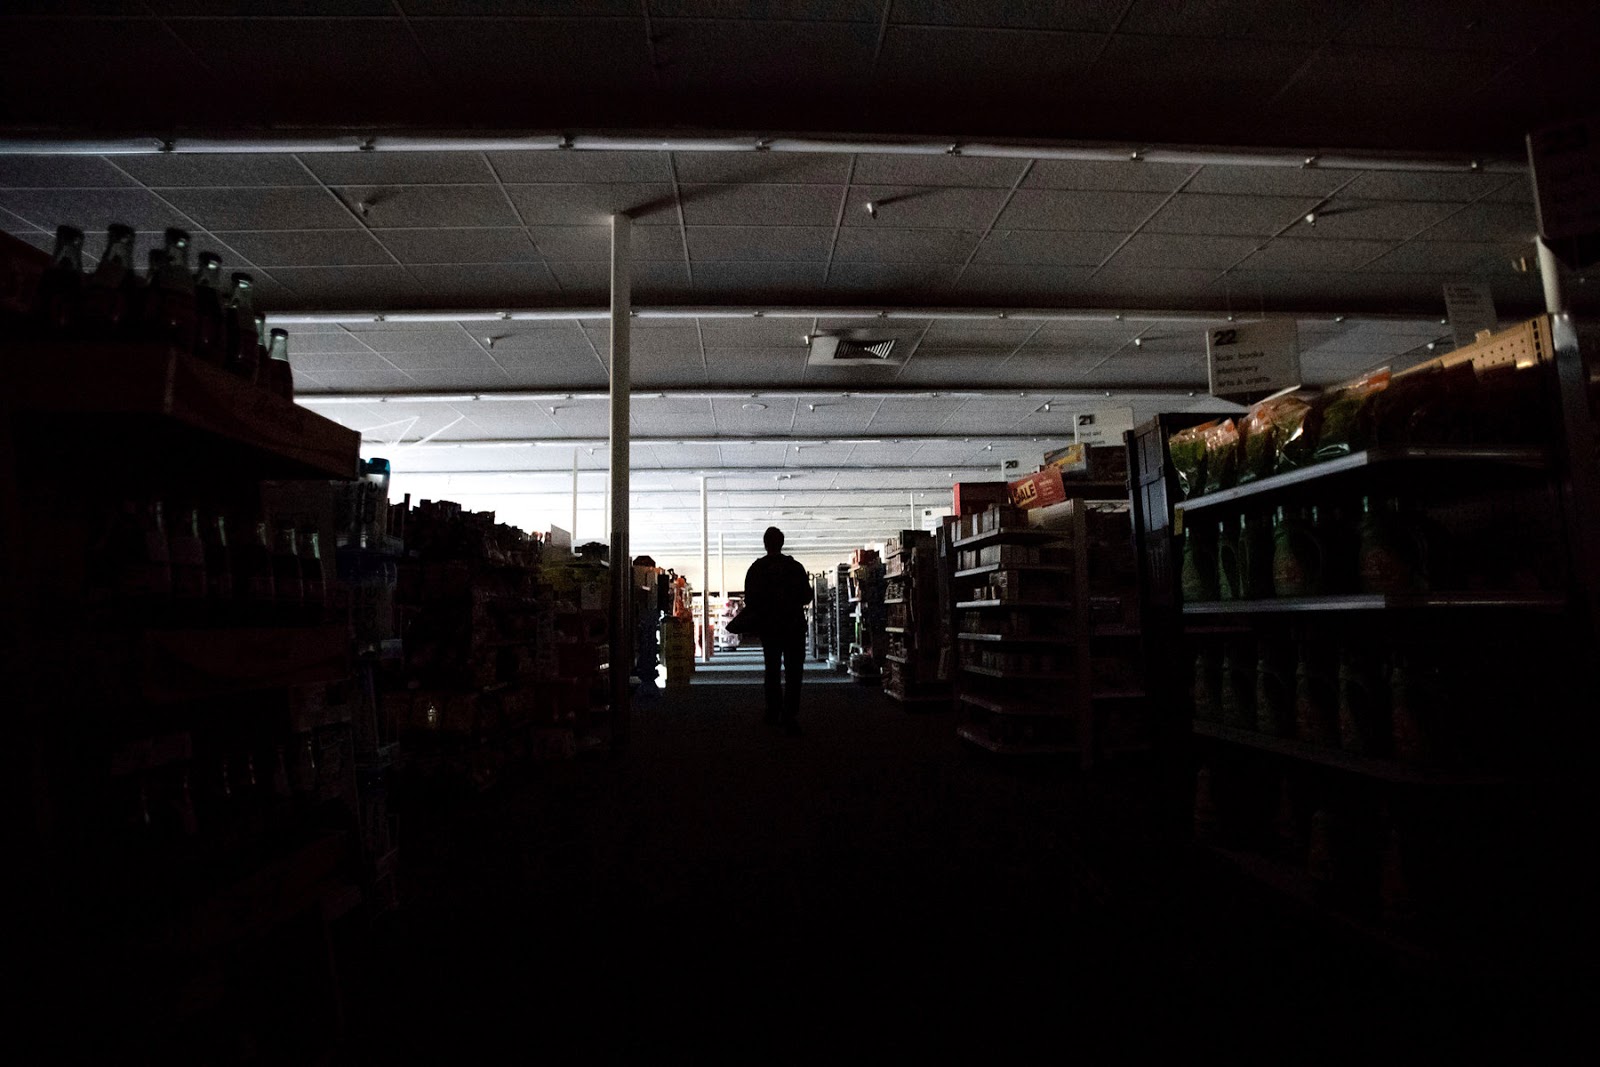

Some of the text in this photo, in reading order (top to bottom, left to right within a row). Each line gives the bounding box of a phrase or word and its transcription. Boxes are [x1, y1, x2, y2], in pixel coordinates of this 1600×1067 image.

[1213, 329, 1237, 346] 22
[1079, 414, 1094, 426] 21
[1005, 460, 1018, 469] 20
[1013, 484, 1036, 504] SALE
